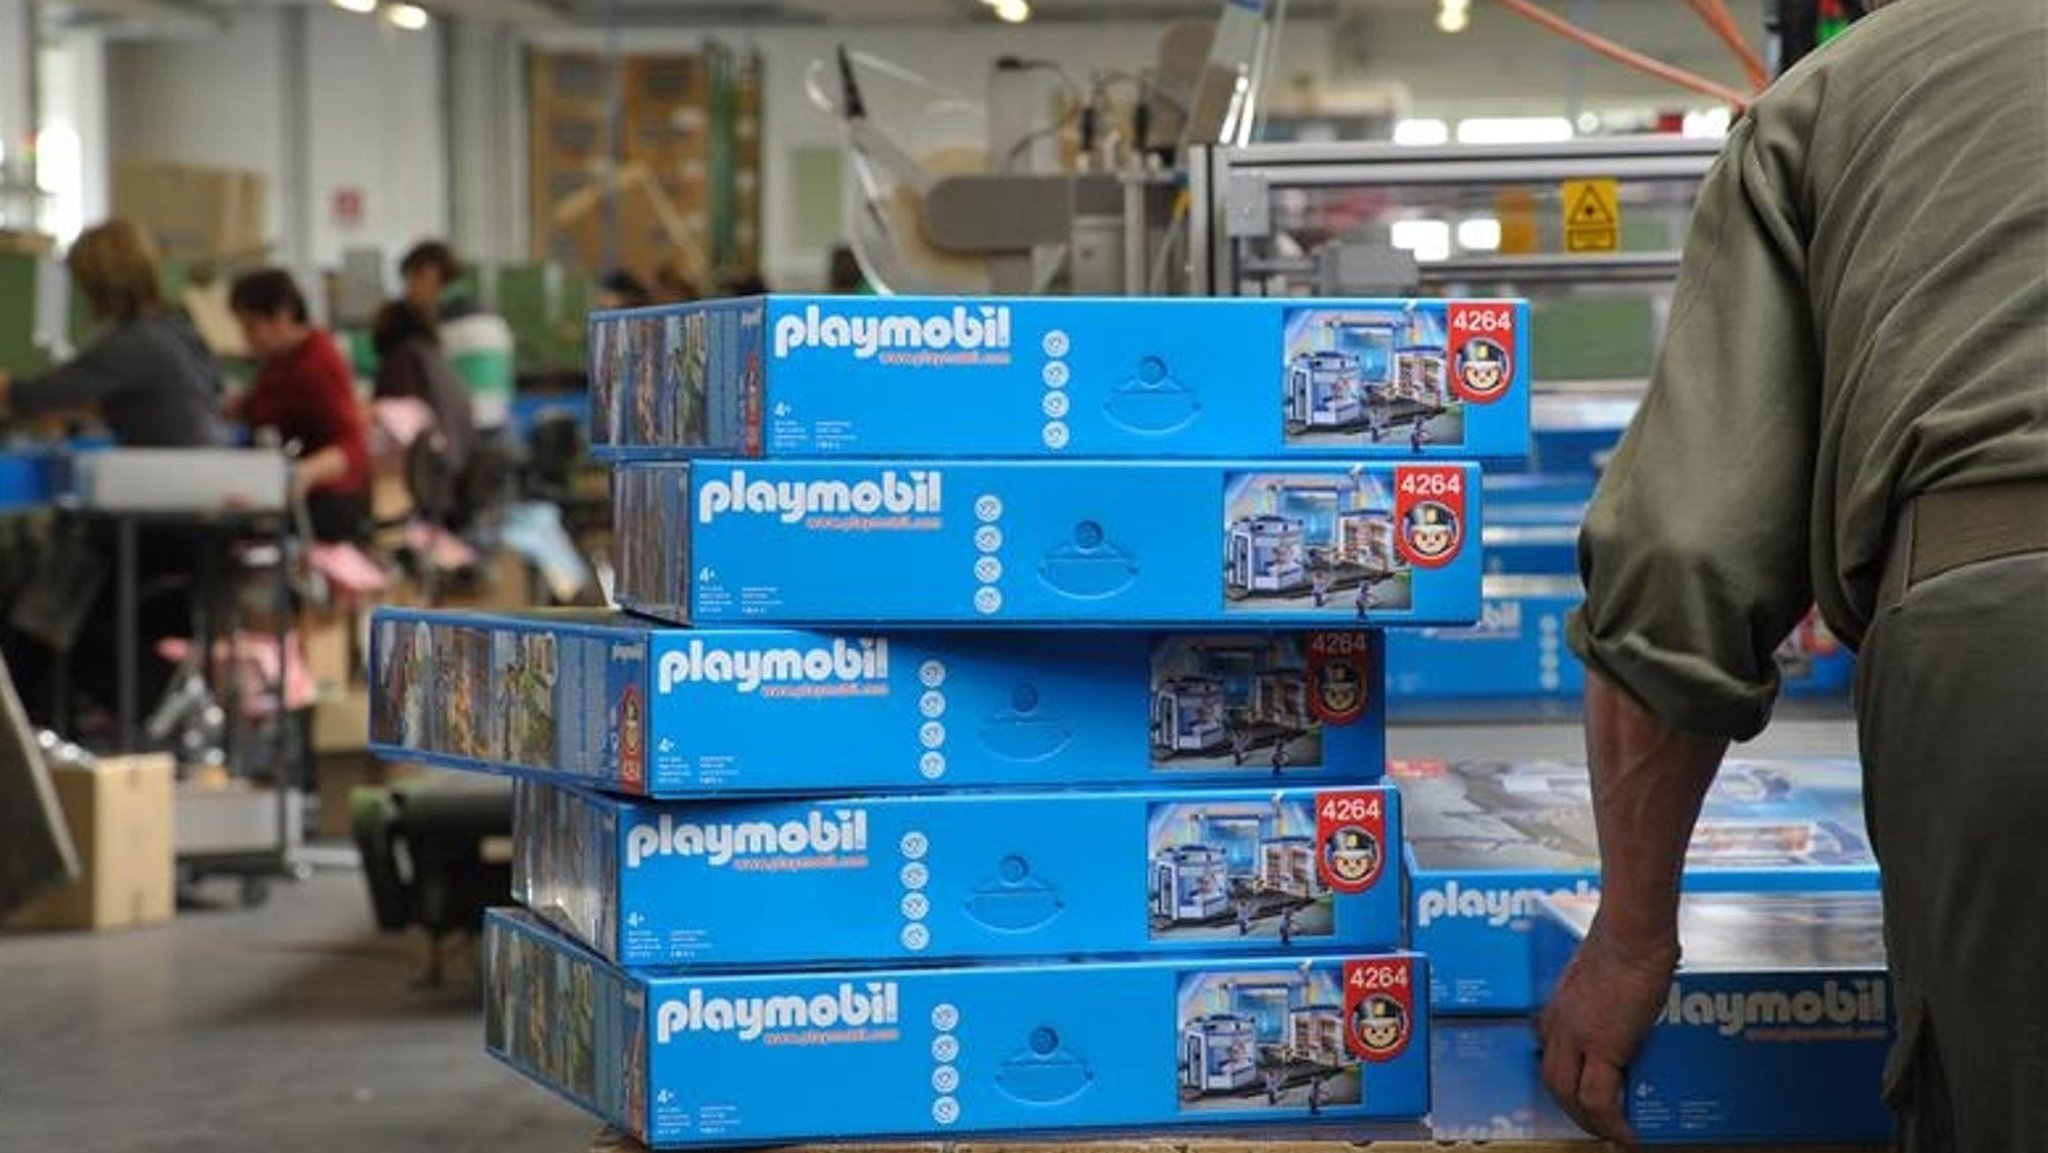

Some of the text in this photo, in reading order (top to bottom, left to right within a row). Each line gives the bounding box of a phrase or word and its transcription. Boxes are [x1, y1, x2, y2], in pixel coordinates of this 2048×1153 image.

[775, 305, 1010, 357] playmobil
[1453, 310, 1511, 330] 4264
[700, 469, 941, 523] playmobil
[1401, 474, 1460, 494] 4264
[659, 638, 889, 694] playmobil
[1312, 632, 1366, 653] 4264
[1321, 799, 1380, 820] 4264
[627, 809, 867, 867] playmobil
[1350, 965, 1407, 988] 4264
[657, 983, 898, 1043] playmobil
[1655, 980, 1885, 1036] laymobil
